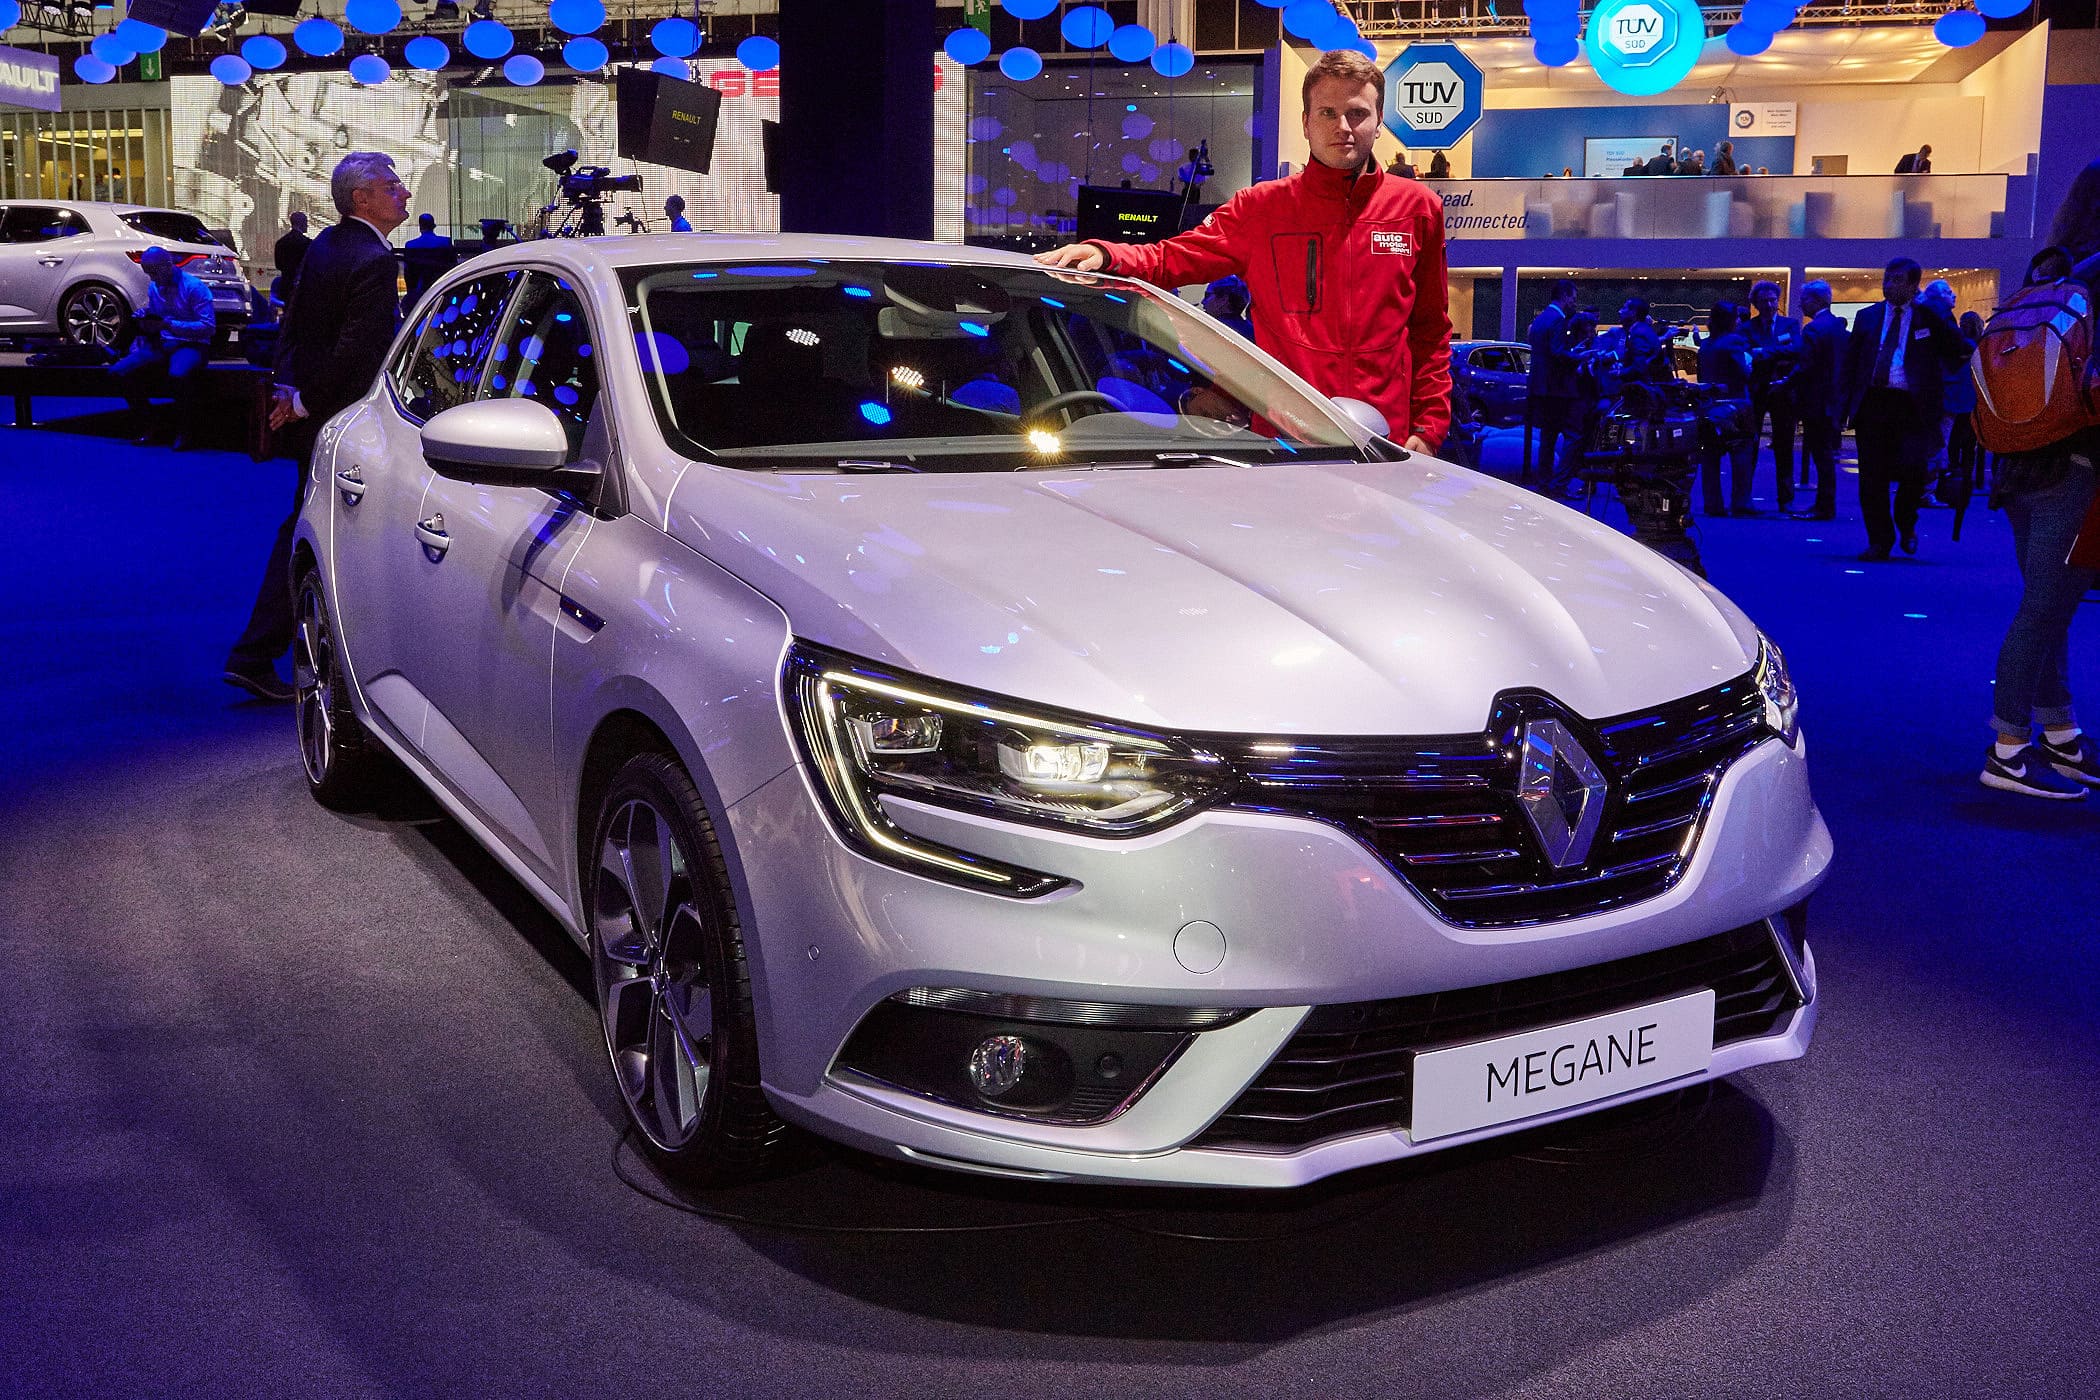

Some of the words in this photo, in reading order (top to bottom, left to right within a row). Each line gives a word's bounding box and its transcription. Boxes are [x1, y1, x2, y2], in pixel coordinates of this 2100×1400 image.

[1616, 17, 1657, 34] TÜV
[1403, 81, 1458, 104] TÜV
[671, 109, 701, 126] RENAULT
[1416, 111, 1443, 124] SÜD
[1118, 213, 1159, 223] RENAULT
[1445, 210, 1530, 229] connected.
[1373, 233, 1403, 242] auto
[1486, 1023, 1658, 1103] MEGANE
